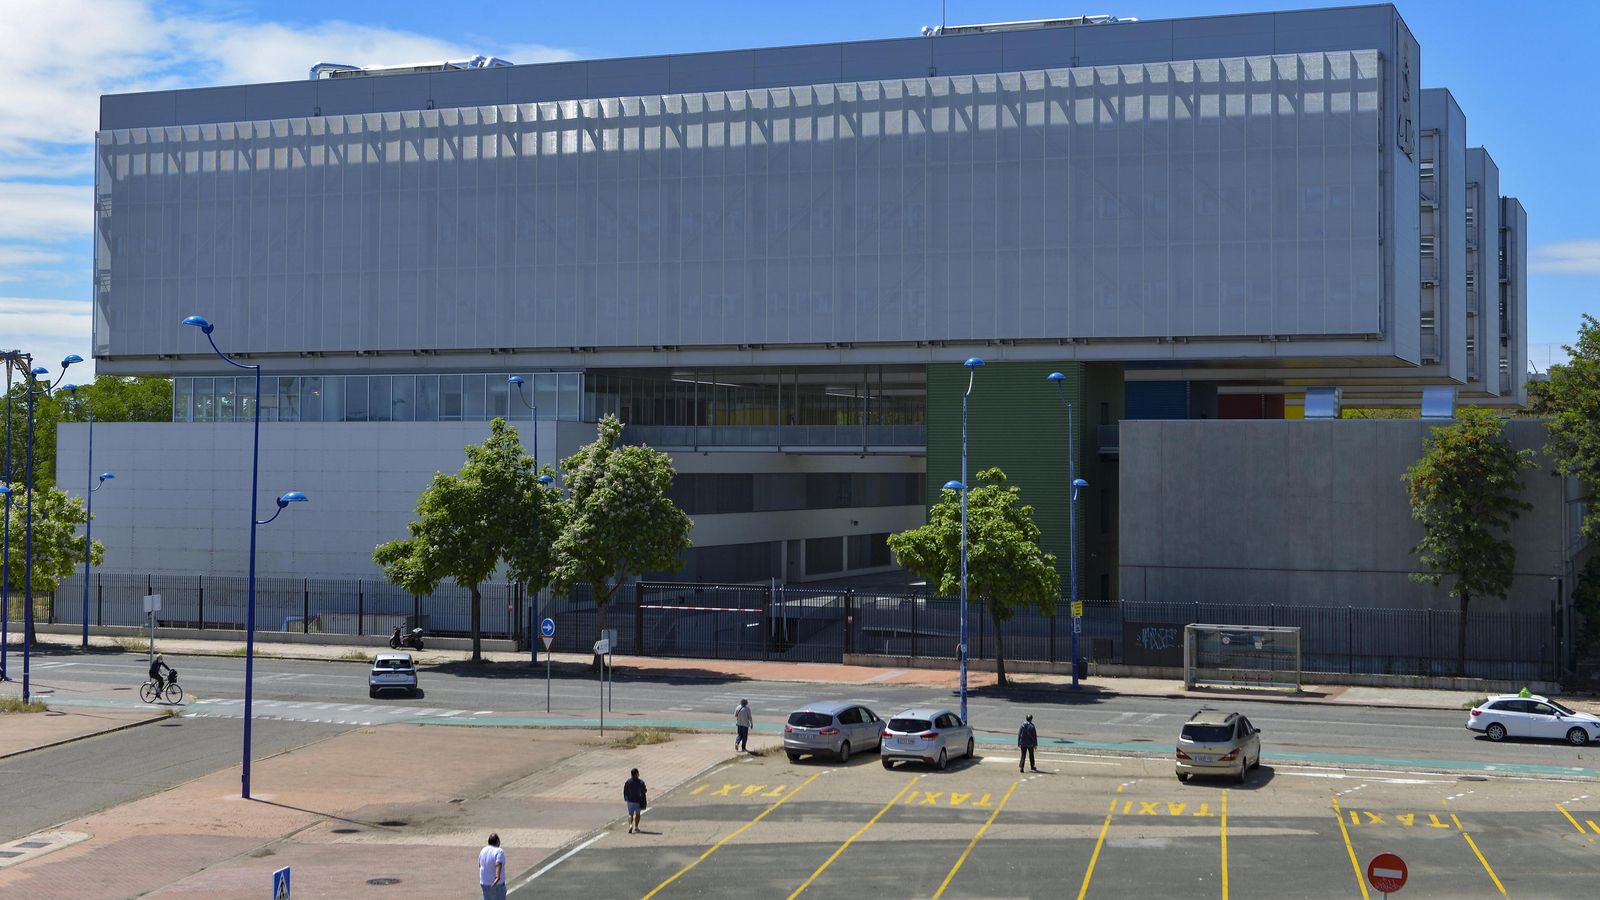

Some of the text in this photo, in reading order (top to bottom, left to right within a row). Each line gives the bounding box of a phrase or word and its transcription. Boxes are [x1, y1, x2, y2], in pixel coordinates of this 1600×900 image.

[689, 783, 788, 797] TAXI
[904, 791, 992, 806] TAXI
[1122, 801, 1214, 816] TAXI
[1349, 810, 1450, 828] TAXI
